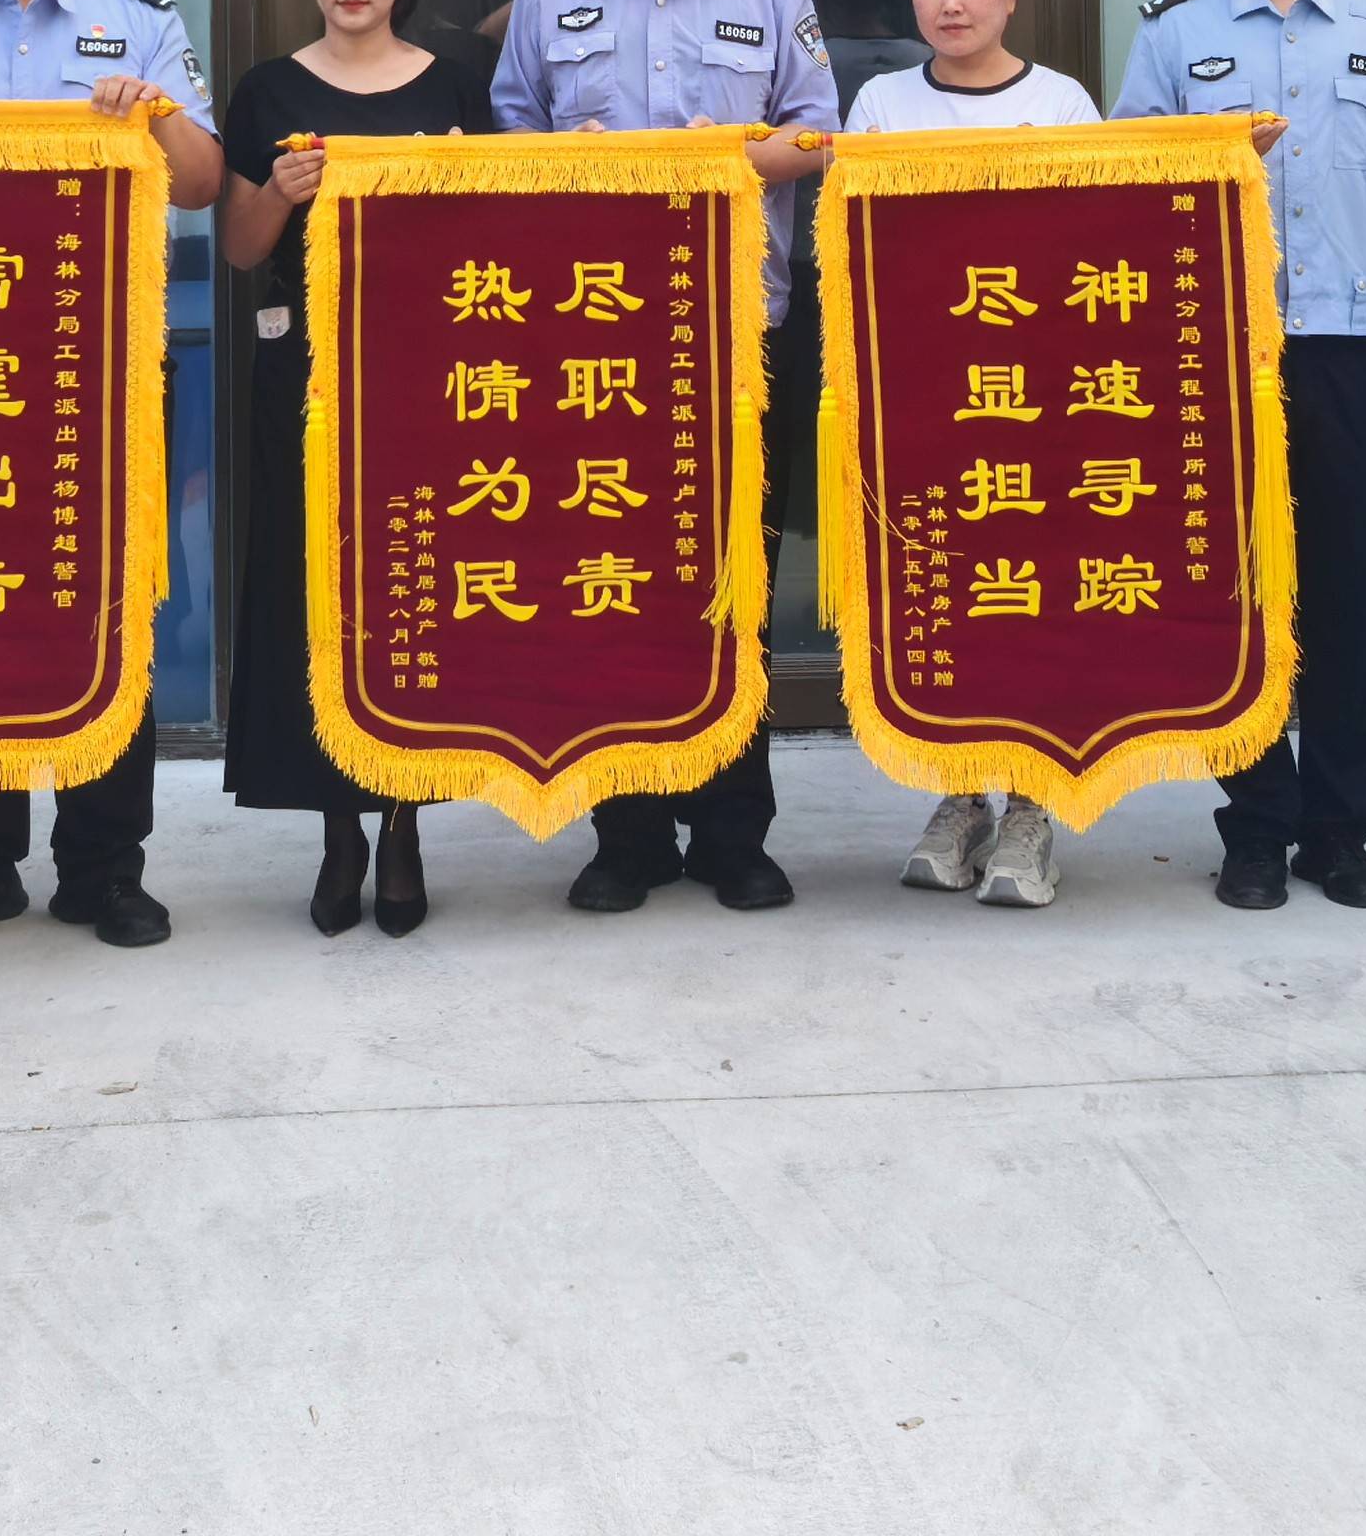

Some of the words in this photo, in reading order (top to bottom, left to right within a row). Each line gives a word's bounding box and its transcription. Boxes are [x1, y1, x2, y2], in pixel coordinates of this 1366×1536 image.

[387, 496, 410, 687] 二零二五年八月四日
[443, 260, 538, 621] 热情为民
[555, 262, 652, 616] 尽职尽责
[900, 495, 926, 685] 二零二五年八月四日
[949, 266, 1047, 618] 尽显担当
[1064, 260, 1161, 614] 神速寻踪
